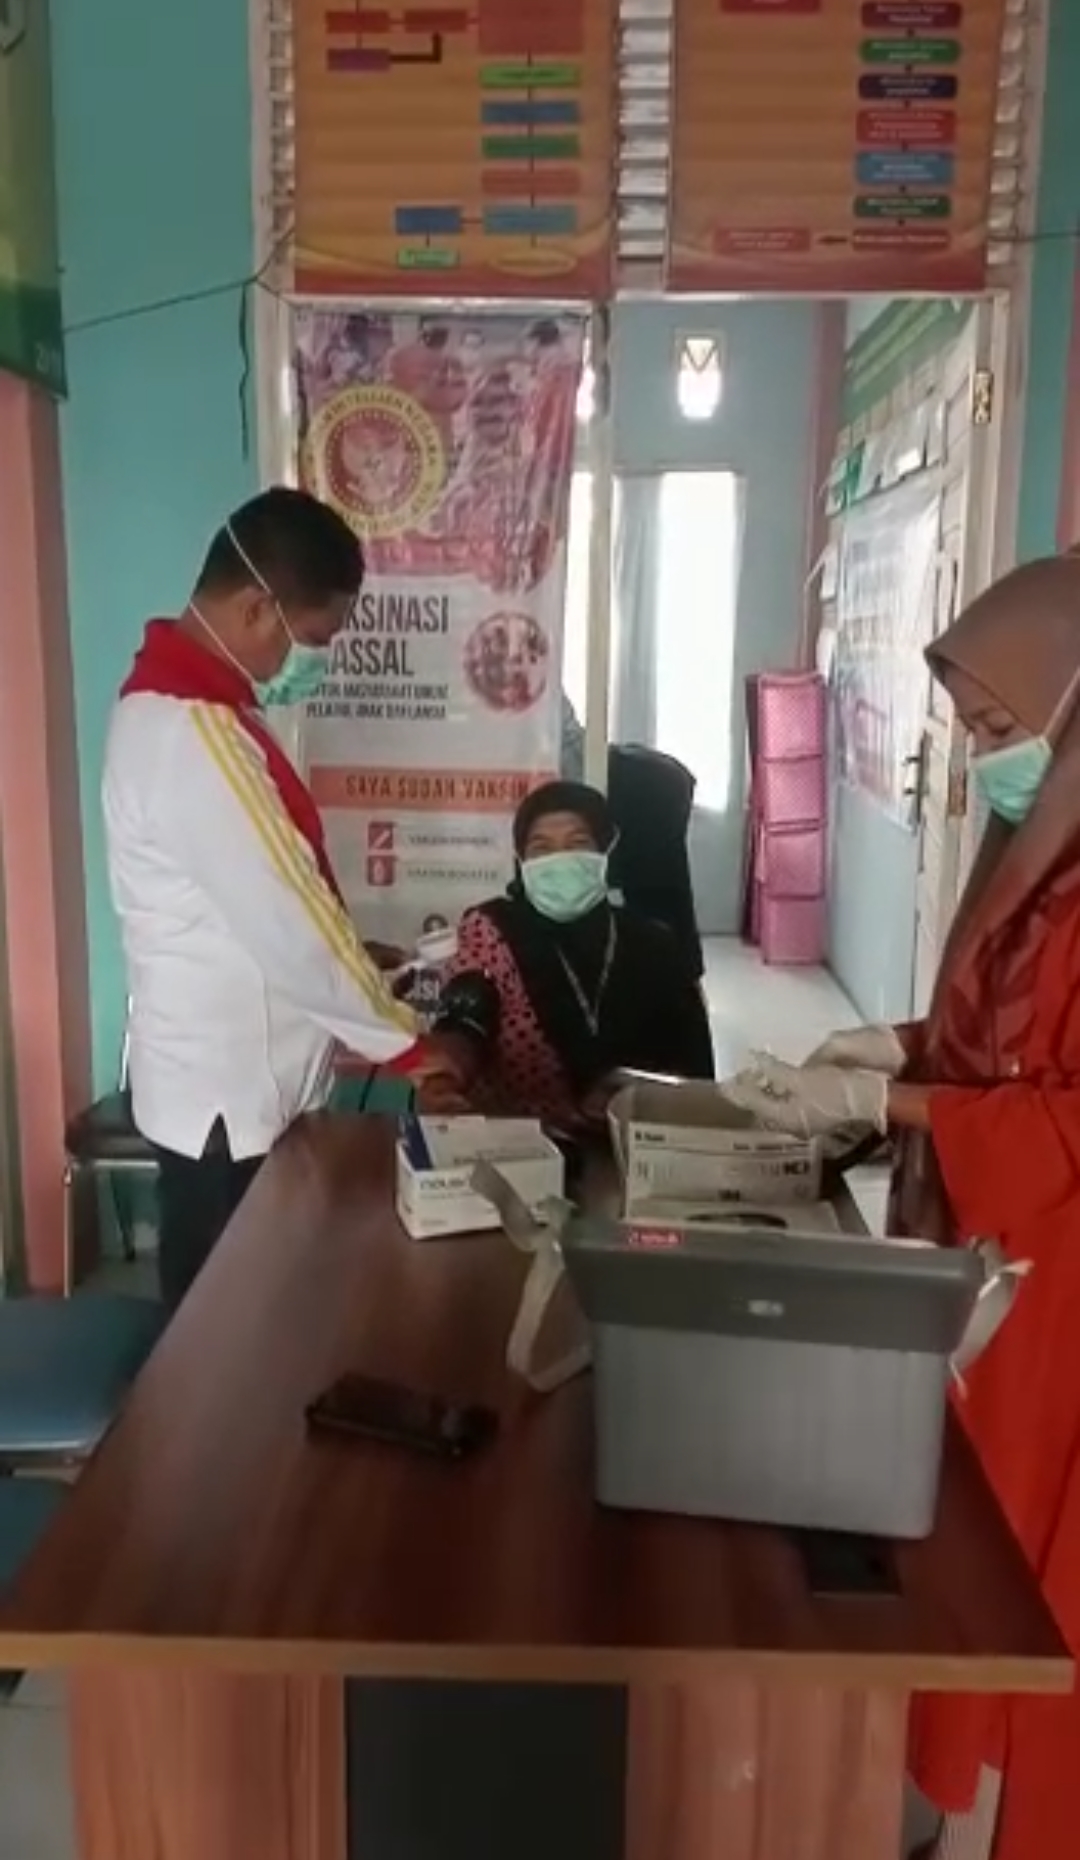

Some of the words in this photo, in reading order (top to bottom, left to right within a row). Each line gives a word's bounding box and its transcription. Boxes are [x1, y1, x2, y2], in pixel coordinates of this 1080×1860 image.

[344, 593, 449, 634] KSINASI
[325, 637, 415, 677] ASSAL
[346, 776, 391, 797] SAYA
[398, 777, 455, 799] SUDAH
